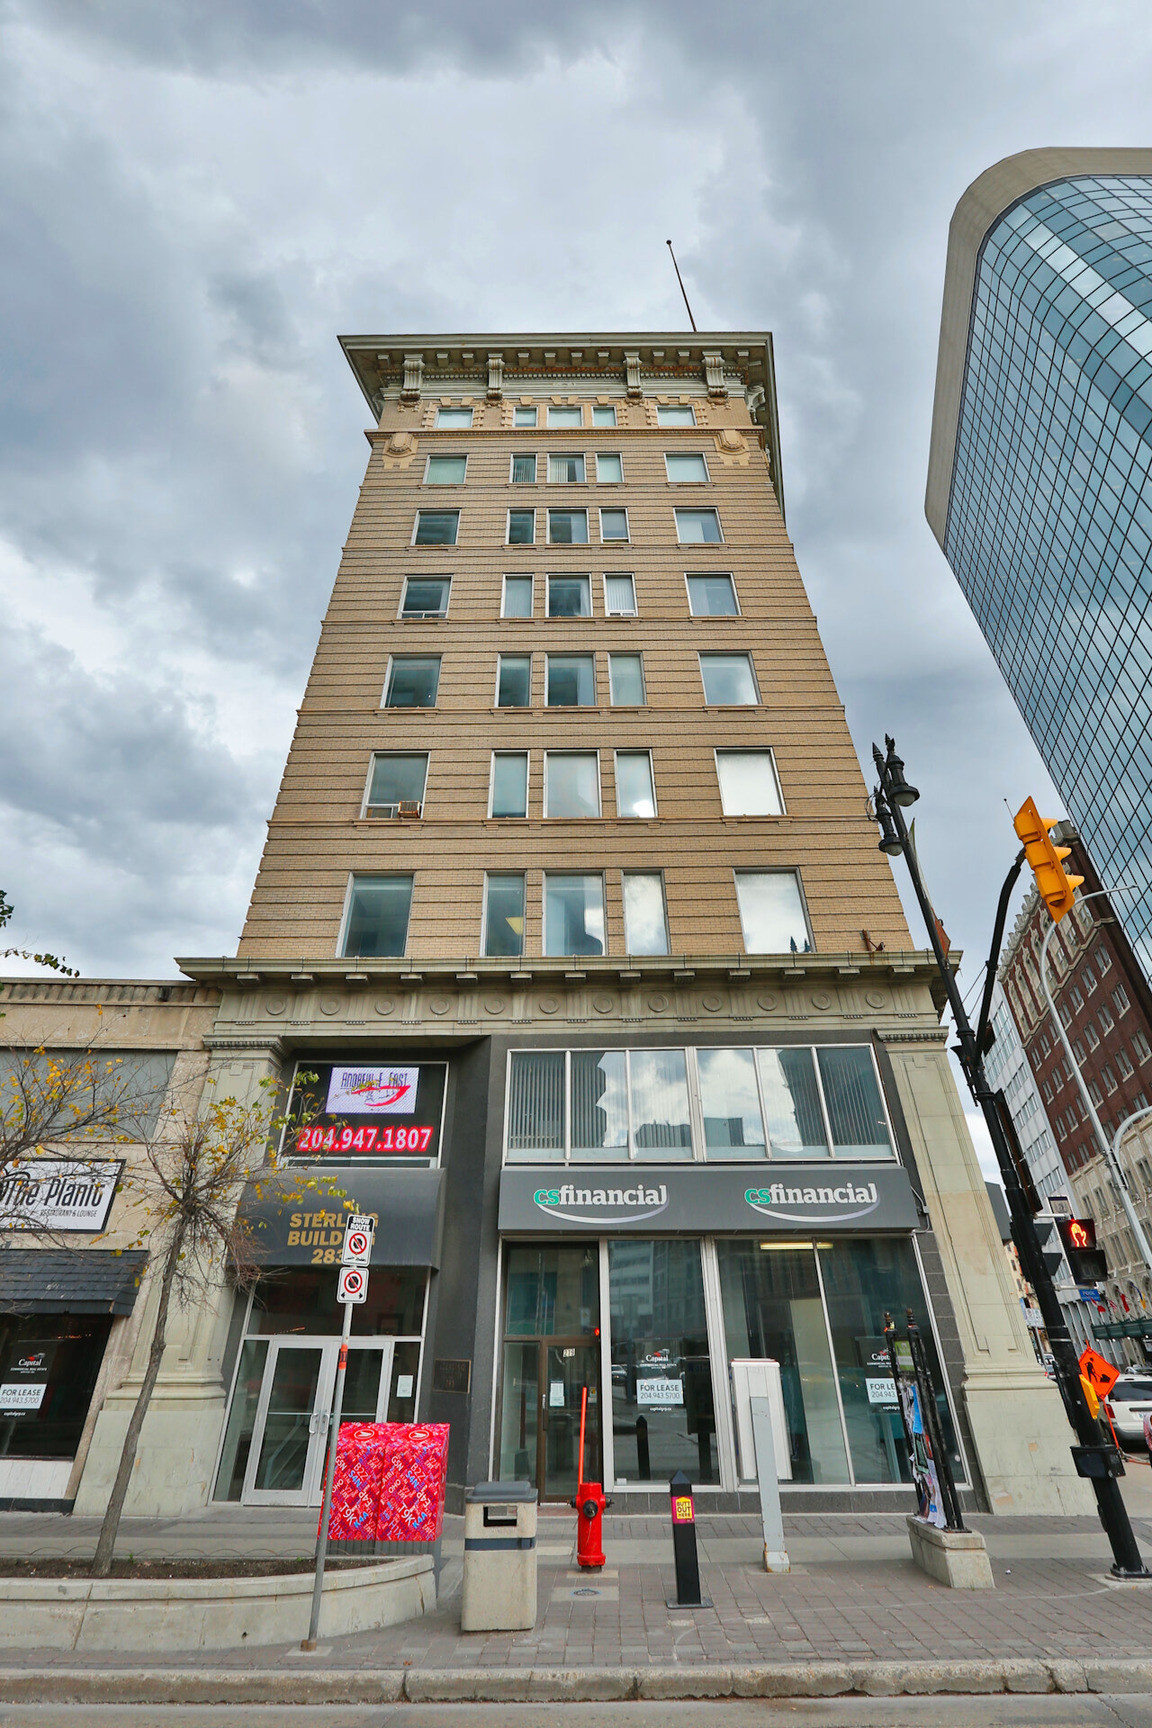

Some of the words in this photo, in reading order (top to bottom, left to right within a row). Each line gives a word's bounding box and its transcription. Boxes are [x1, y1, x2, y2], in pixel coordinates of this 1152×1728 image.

[299, 1127, 433, 1150] 204.947.1807
[43, 1178, 105, 1207] Planit
[533, 1184, 668, 1206] csfinancial
[744, 1183, 879, 1205] csfinancial
[77, 1209, 98, 1218] LOUNGE
[289, 1212, 379, 1228] STERLG
[352, 1216, 370, 1225] SNOW
[350, 1223, 370, 1232] ROUTE
[287, 1230, 375, 1246] BUILD
[18, 1358, 42, 1367] Capital
[645, 1354, 669, 1362] Capital
[640, 1384, 656, 1392] FOR
[656, 1384, 679, 1392] LEASE
[354, 1462, 369, 1481] B2Z
[411, 1462, 426, 1481] B2Z
[340, 1502, 356, 1526] T9K
[398, 1502, 415, 1526] T9K
